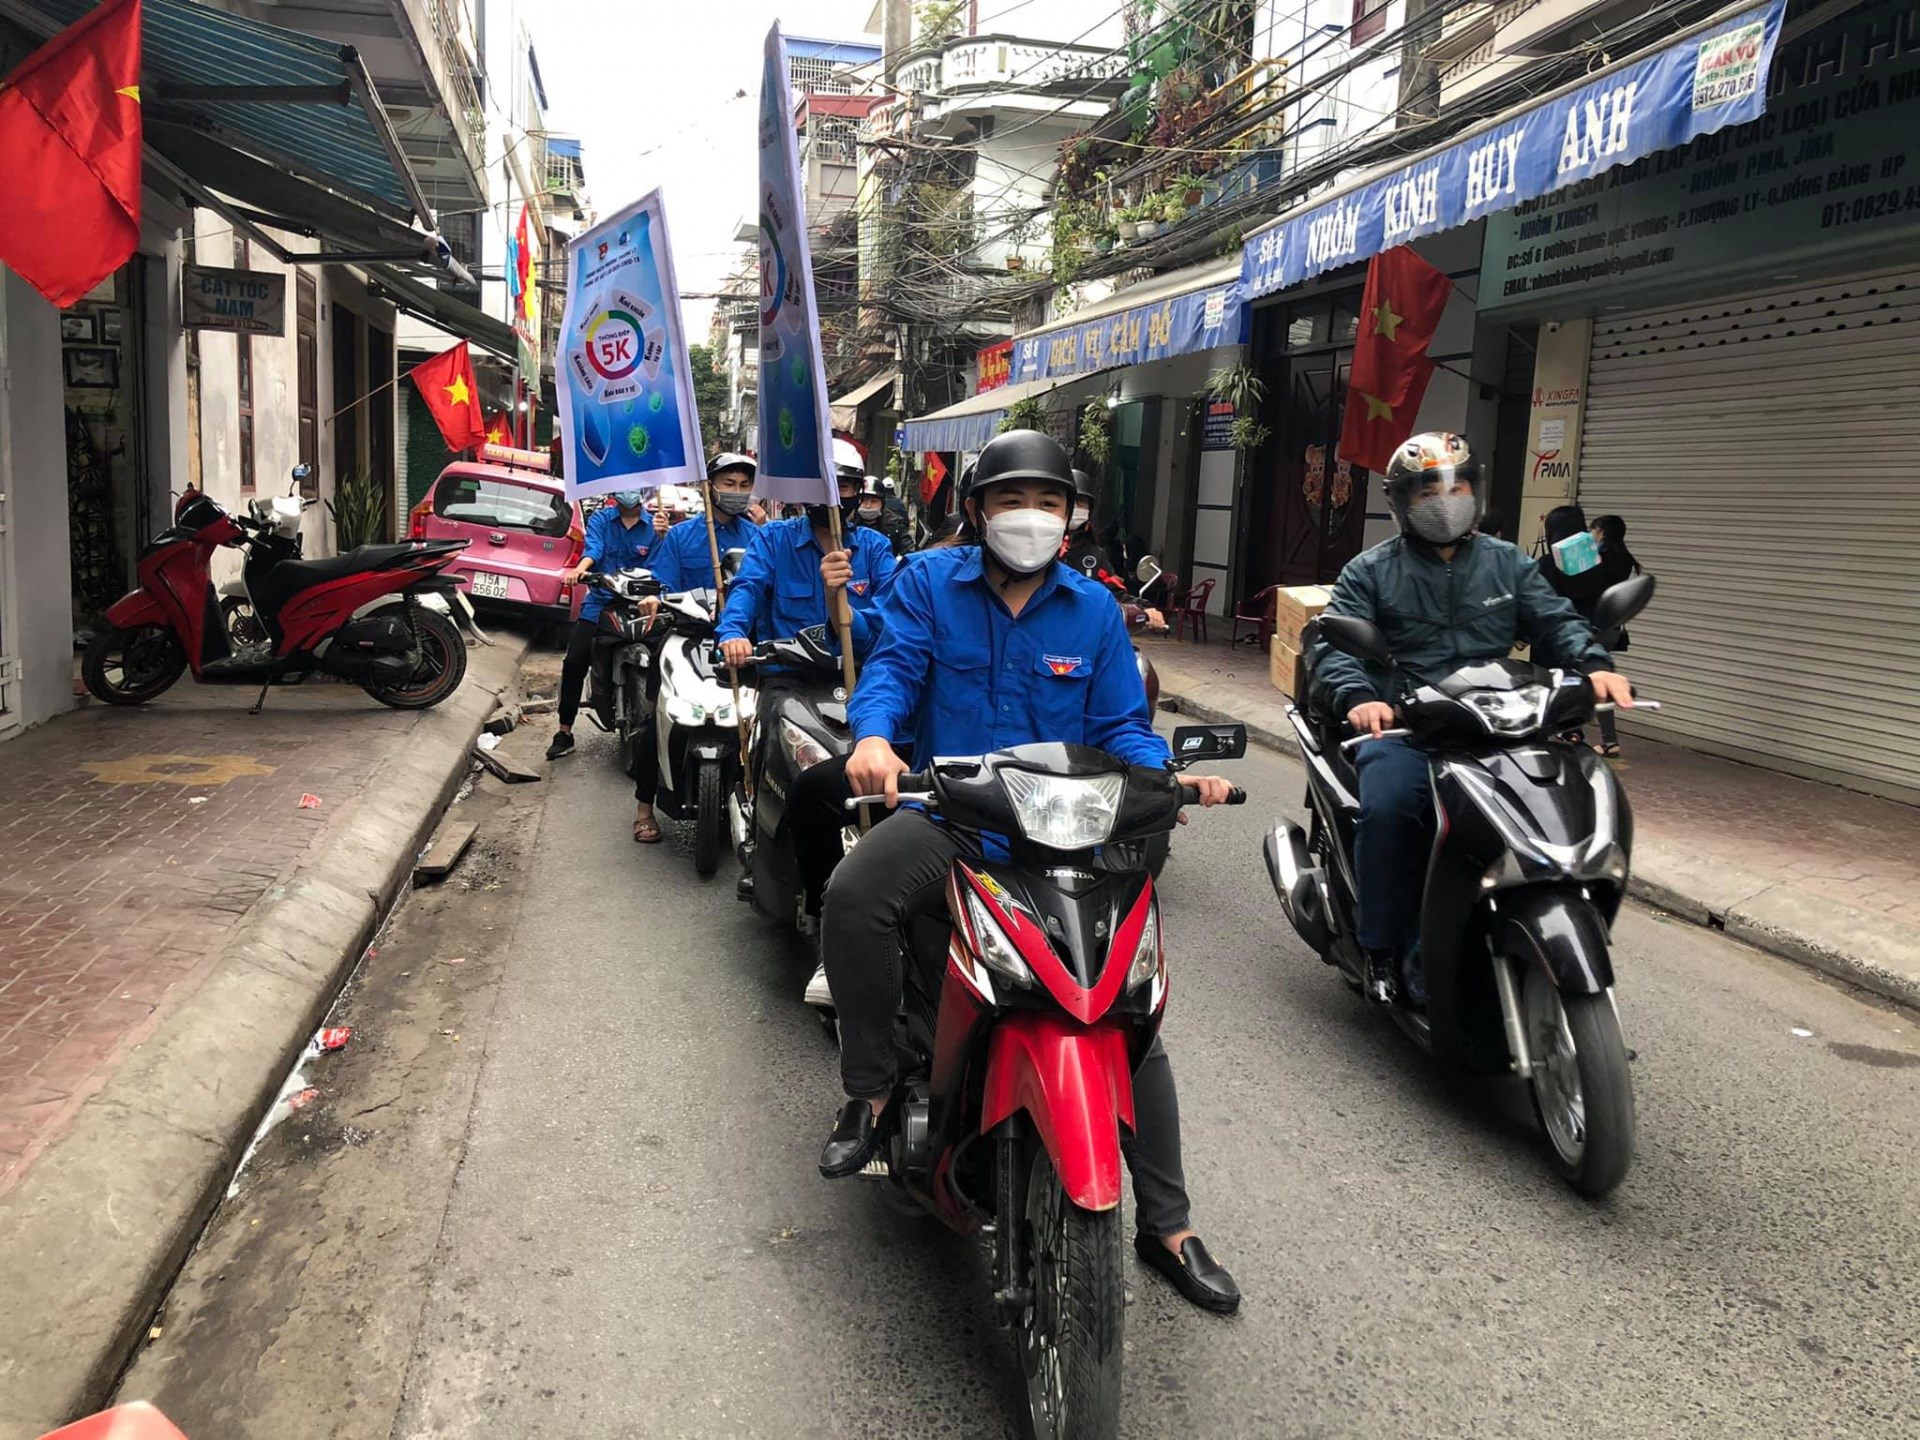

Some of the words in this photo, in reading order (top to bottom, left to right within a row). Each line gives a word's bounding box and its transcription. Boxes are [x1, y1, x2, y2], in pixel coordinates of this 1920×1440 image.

[1305, 198, 1361, 268] NHÔM
[1383, 166, 1440, 239] KÍNH
[1465, 129, 1525, 209] HUY
[1557, 81, 1637, 175] ANH
[1880, 153, 1907, 179] HP
[215, 298, 255, 318] NAM
[601, 337, 631, 366] 5K
[1547, 387, 1580, 401] XINGFA
[1541, 462, 1571, 478] PMA
[483, 573, 500, 586] 15A
[1045, 869, 1096, 881] HONDA
